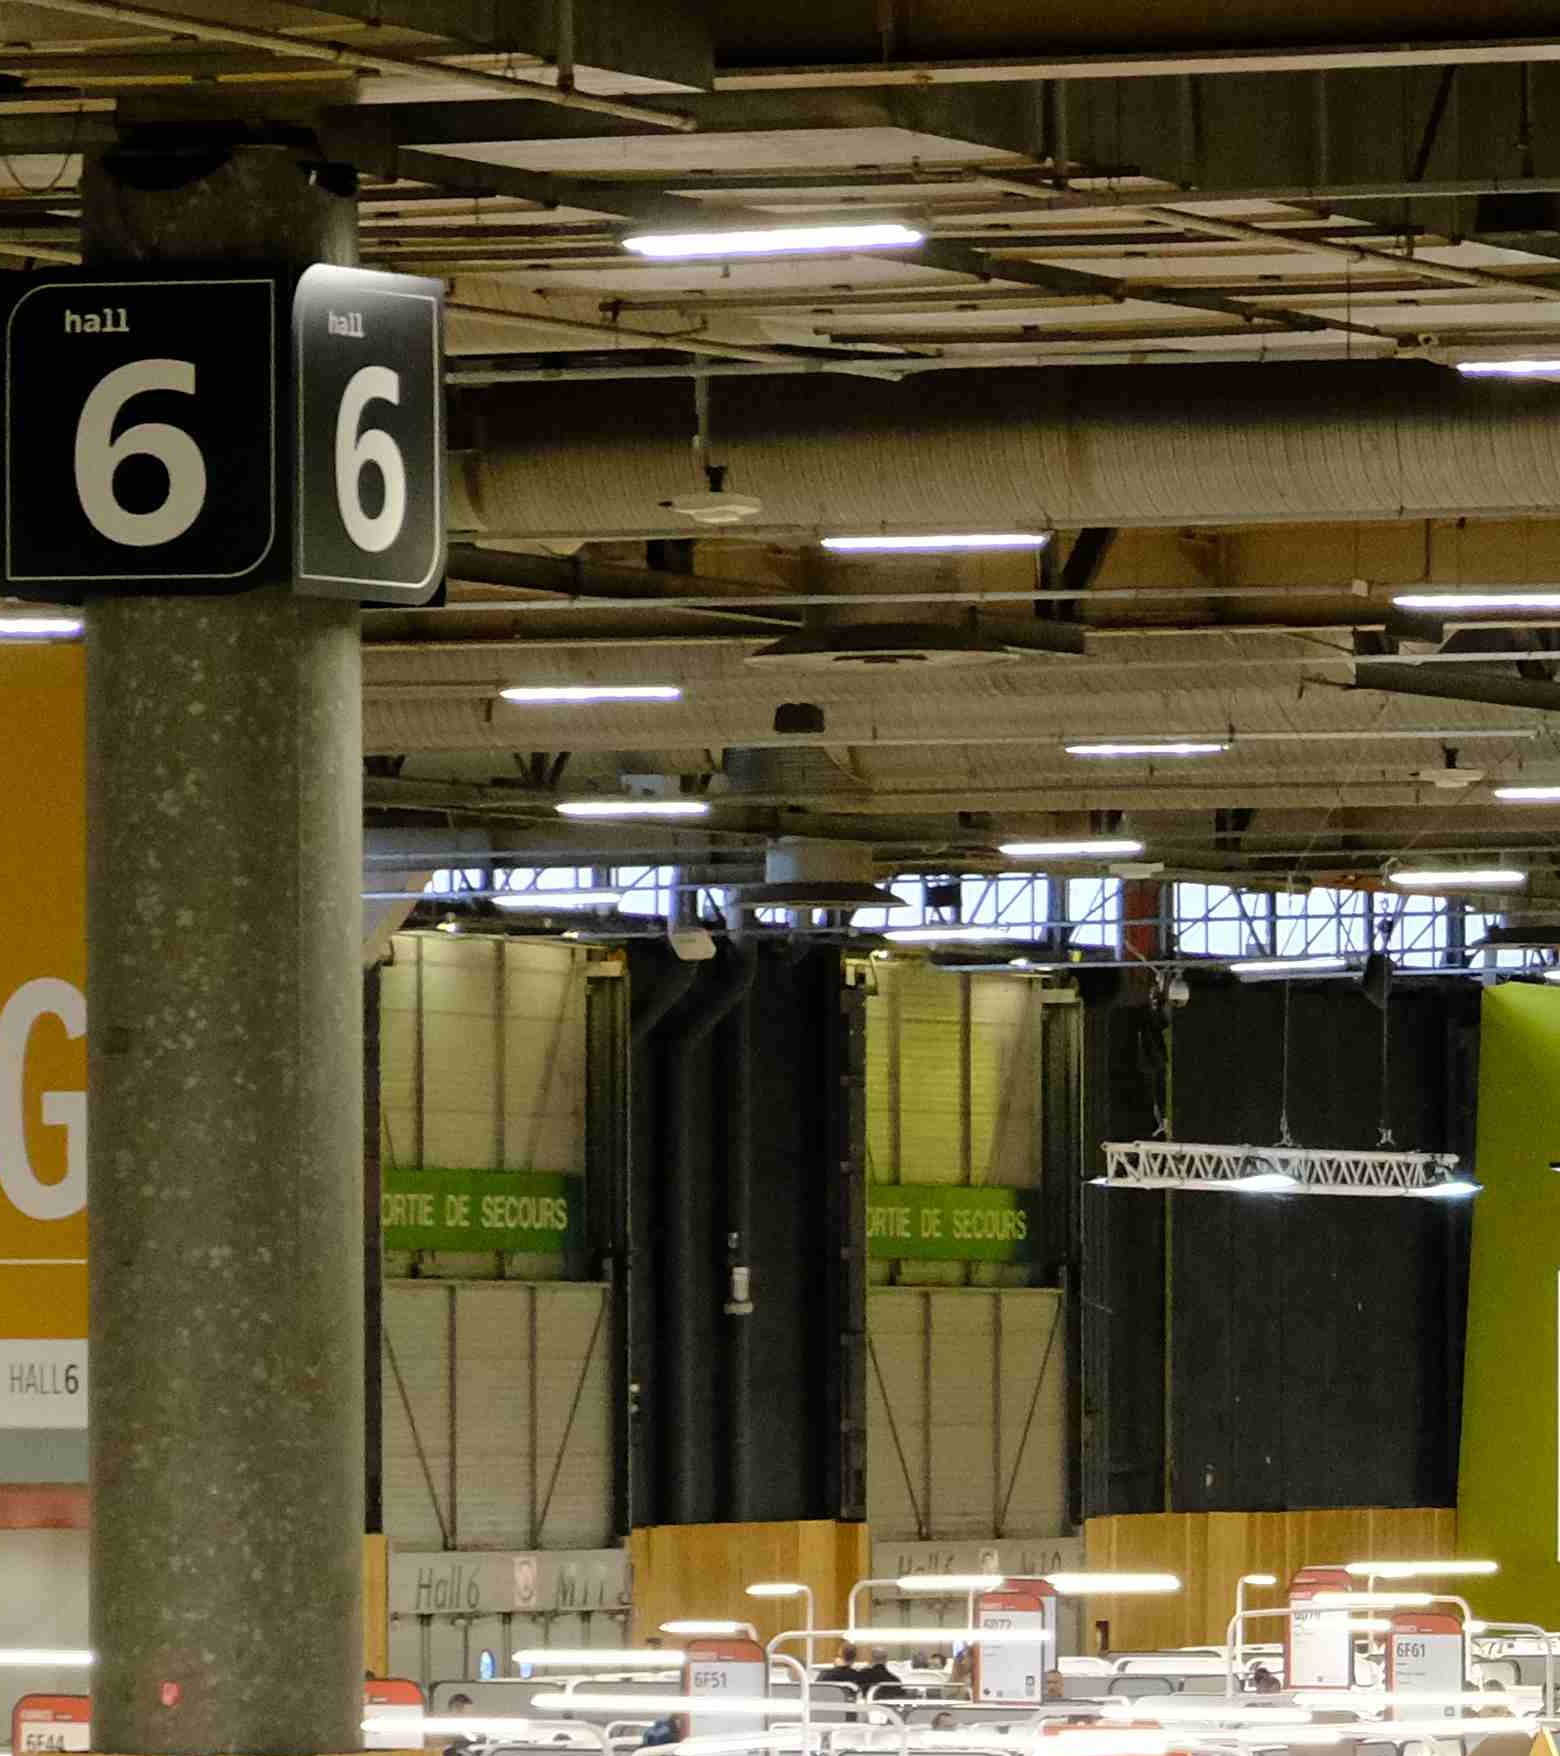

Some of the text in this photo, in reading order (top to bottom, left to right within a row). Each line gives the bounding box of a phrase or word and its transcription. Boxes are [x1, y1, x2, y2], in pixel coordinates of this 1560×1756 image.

[64, 308, 131, 334] hall
[327, 311, 364, 338] hall
[73, 358, 207, 547] 6
[336, 366, 407, 553] 6
[379, 1194, 568, 1231] ORTIE DE SECOURS
[865, 1206, 1028, 1240] ORTIE DE SECOURS
[694, 1672, 728, 1689] 6F51
